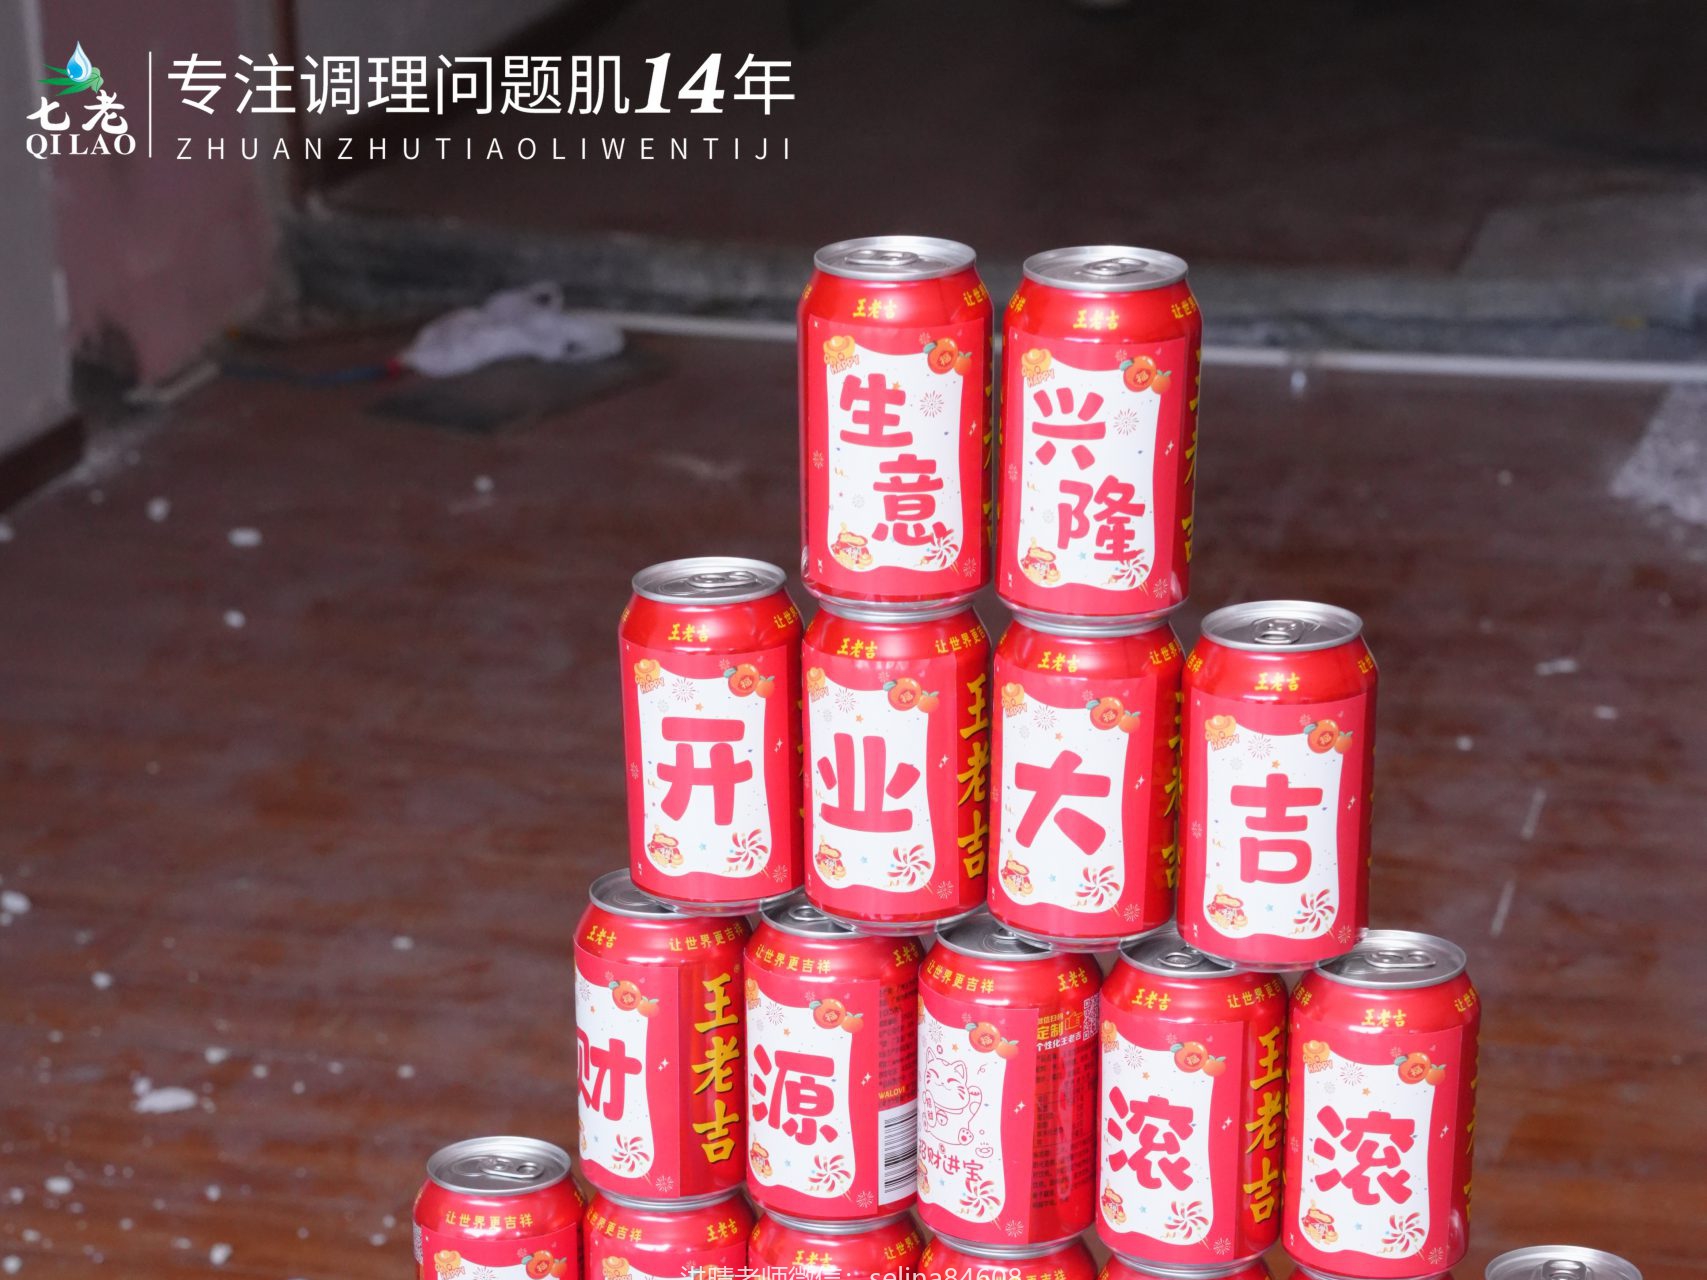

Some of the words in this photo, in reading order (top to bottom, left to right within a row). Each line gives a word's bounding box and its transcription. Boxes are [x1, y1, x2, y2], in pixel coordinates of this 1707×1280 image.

[853, 298, 897, 320] 王老吉
[1073, 309, 1119, 331] 王老吉
[668, 623, 710, 642] 王老吉
[837, 637, 878, 660] 王老吉
[1037, 651, 1080, 673] 王老吉
[1254, 673, 1300, 691] 王老吉
[657, 716, 753, 826] 开
[817, 733, 921, 833] 业
[957, 673, 990, 880] 王老吉
[1014, 750, 1111, 856] 大
[1230, 773, 1324, 884] 吉
[587, 925, 617, 949] 王老吉
[668, 922, 744, 952] 让世界更吉祥
[755, 944, 831, 974] 让世界更吉祥
[926, 960, 995, 994] 让世界更吉祥
[1057, 968, 1088, 992] 王老吉
[1131, 989, 1172, 1011] 王老吉
[1361, 1009, 1407, 1028] 王老吉
[1036, 1031, 1082, 1052] 个性化王老吉
[1037, 1021, 1064, 1041] 定制
[576, 1028, 643, 1121] 财
[691, 973, 741, 1164] 王老吉
[751, 1044, 838, 1146] 源
[1243, 1026, 1284, 1223] 王老吉
[1107, 1086, 1194, 1192] 滚
[1313, 1105, 1416, 1206] 滚
[445, 1210, 534, 1230] 让世界更吉祥
[706, 1218, 738, 1242] 王老吉
[792, 1250, 833, 1268] 王老吉
